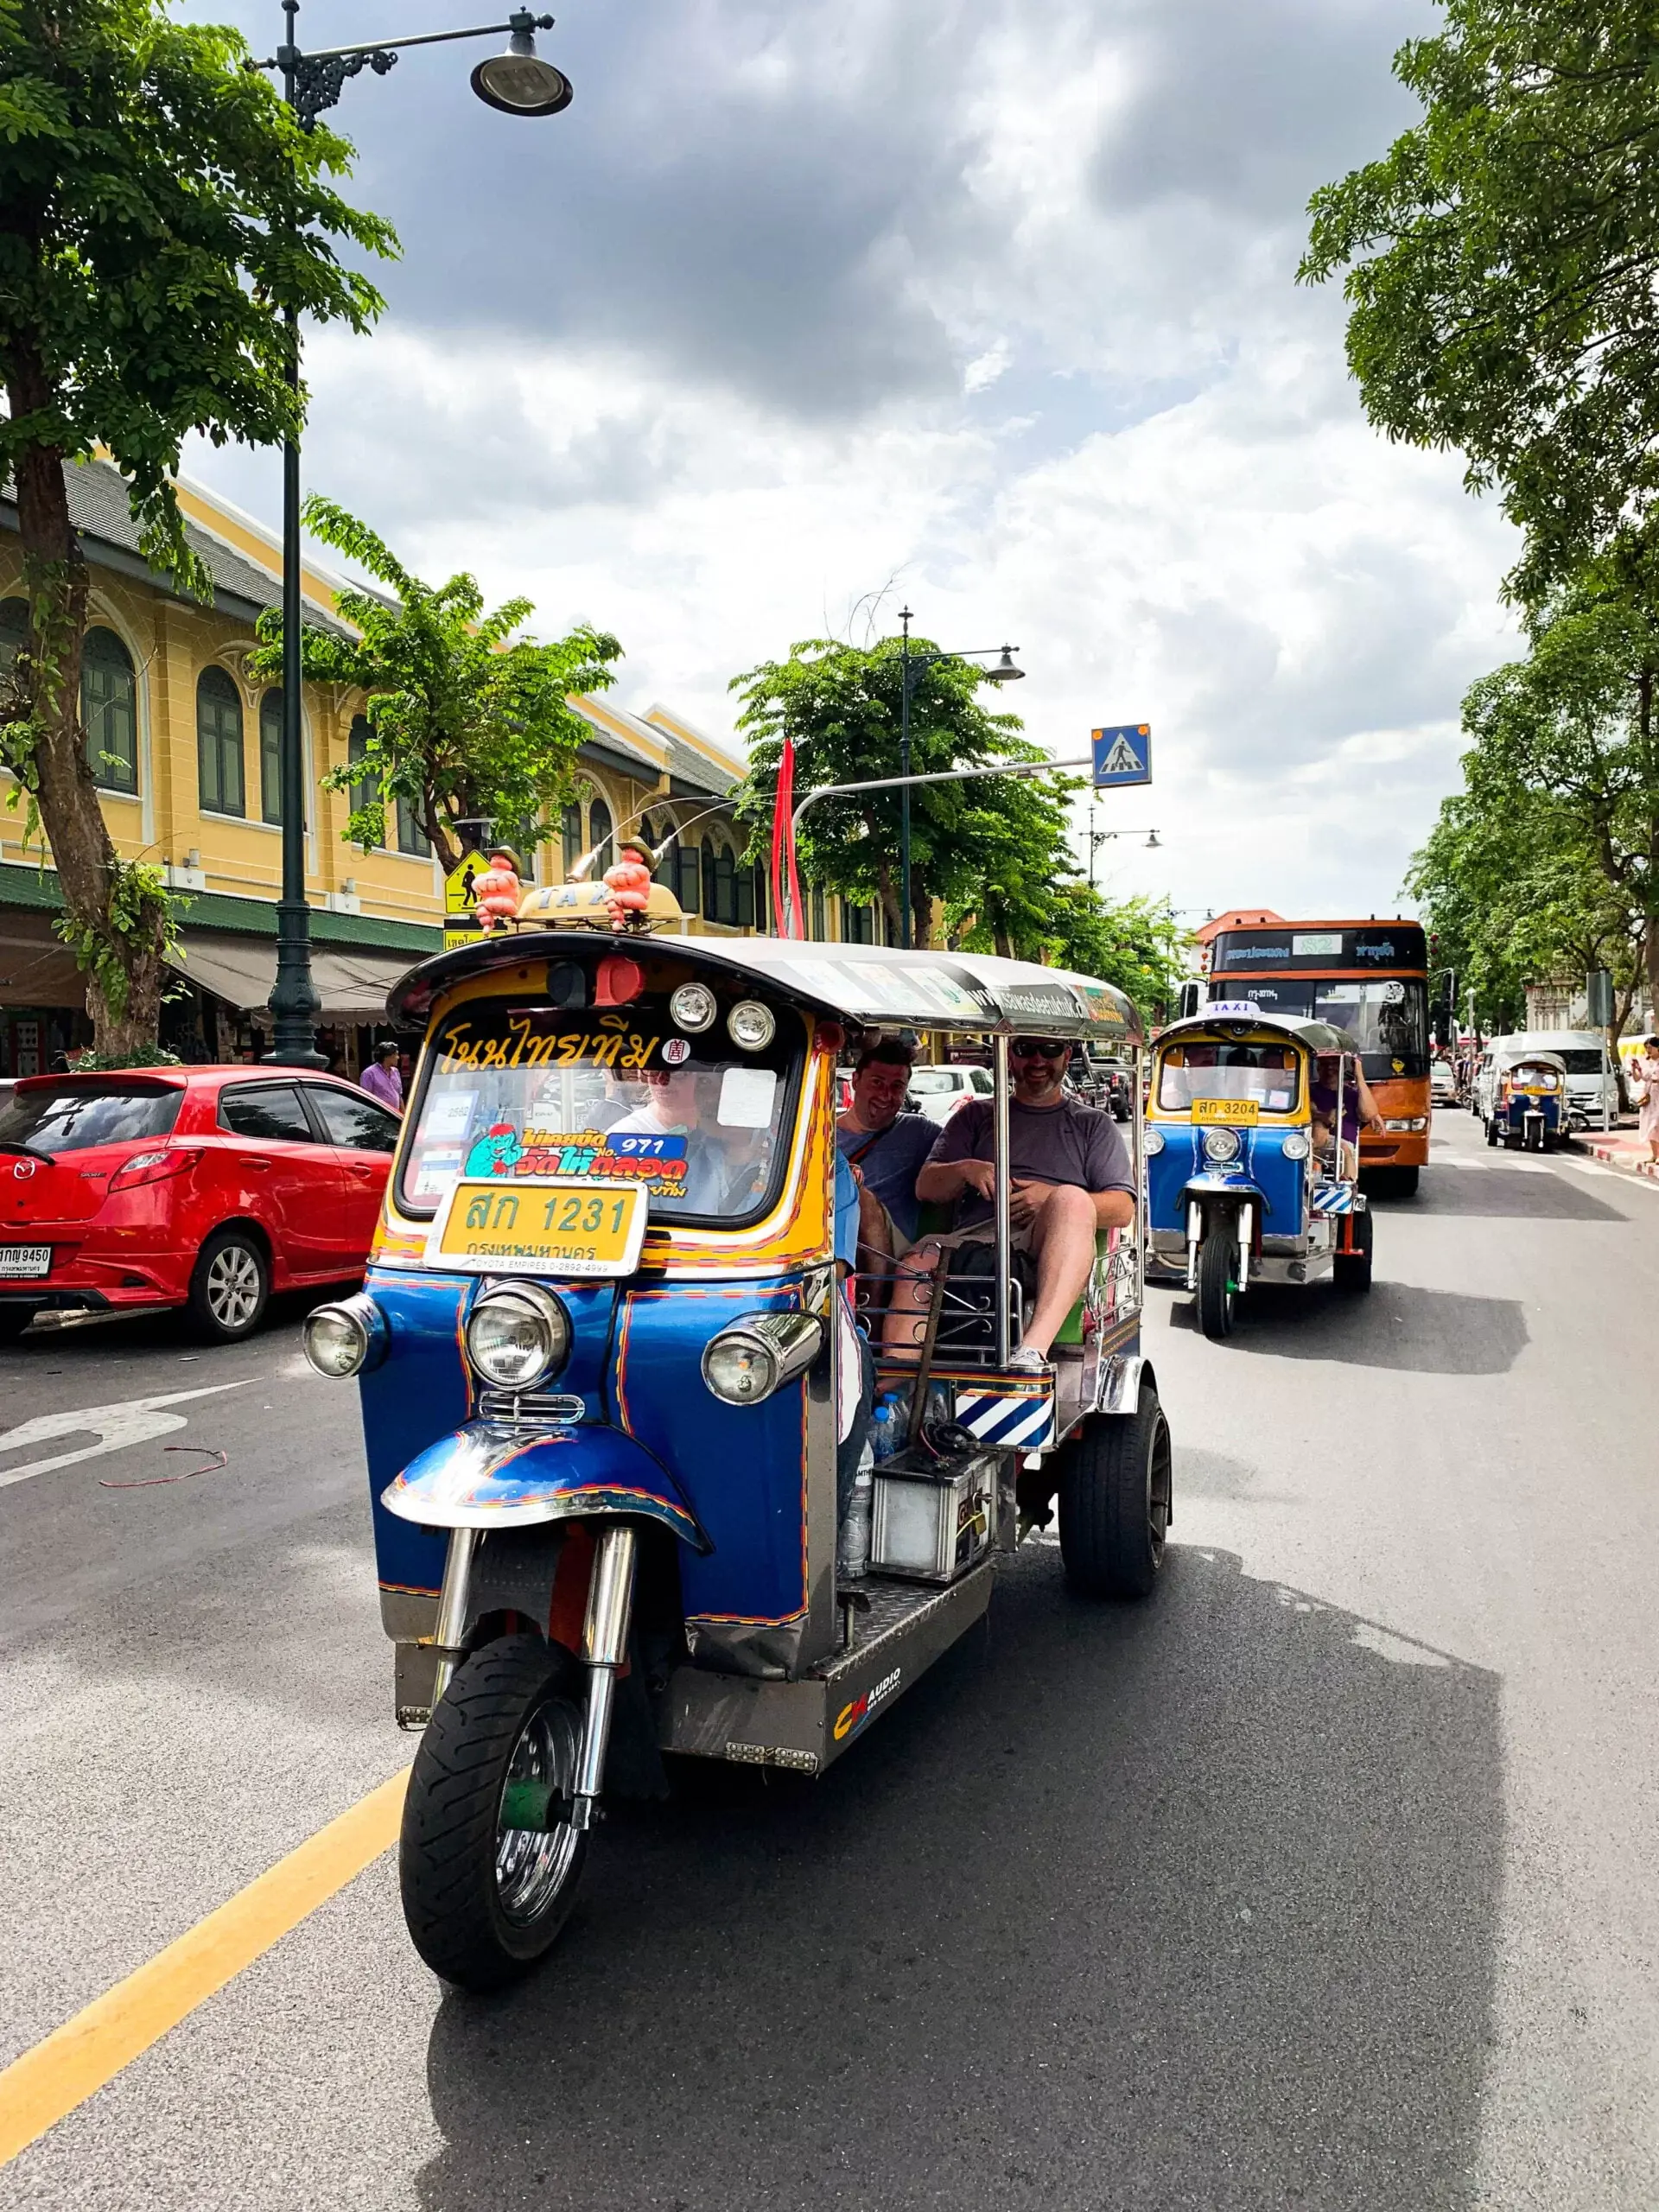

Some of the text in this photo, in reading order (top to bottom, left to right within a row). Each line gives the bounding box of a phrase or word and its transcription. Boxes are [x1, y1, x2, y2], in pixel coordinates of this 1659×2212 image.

[538, 883, 608, 909] TAX
[1301, 936, 1333, 955] 82
[1212, 1002, 1248, 1011] TAXI
[1199, 1101, 1255, 1115] สก 3204
[621, 1138, 665, 1155] 971
[466, 1192, 626, 1234] สก 1231
[22, 1249, 48, 1262] 9450
[467, 1242, 597, 1261] กรงเทพมหานคร
[473, 1259, 507, 1268] TOYOTA
[509, 1261, 546, 1270] EMPIRES
[868, 1667, 901, 1705] AUDIO
